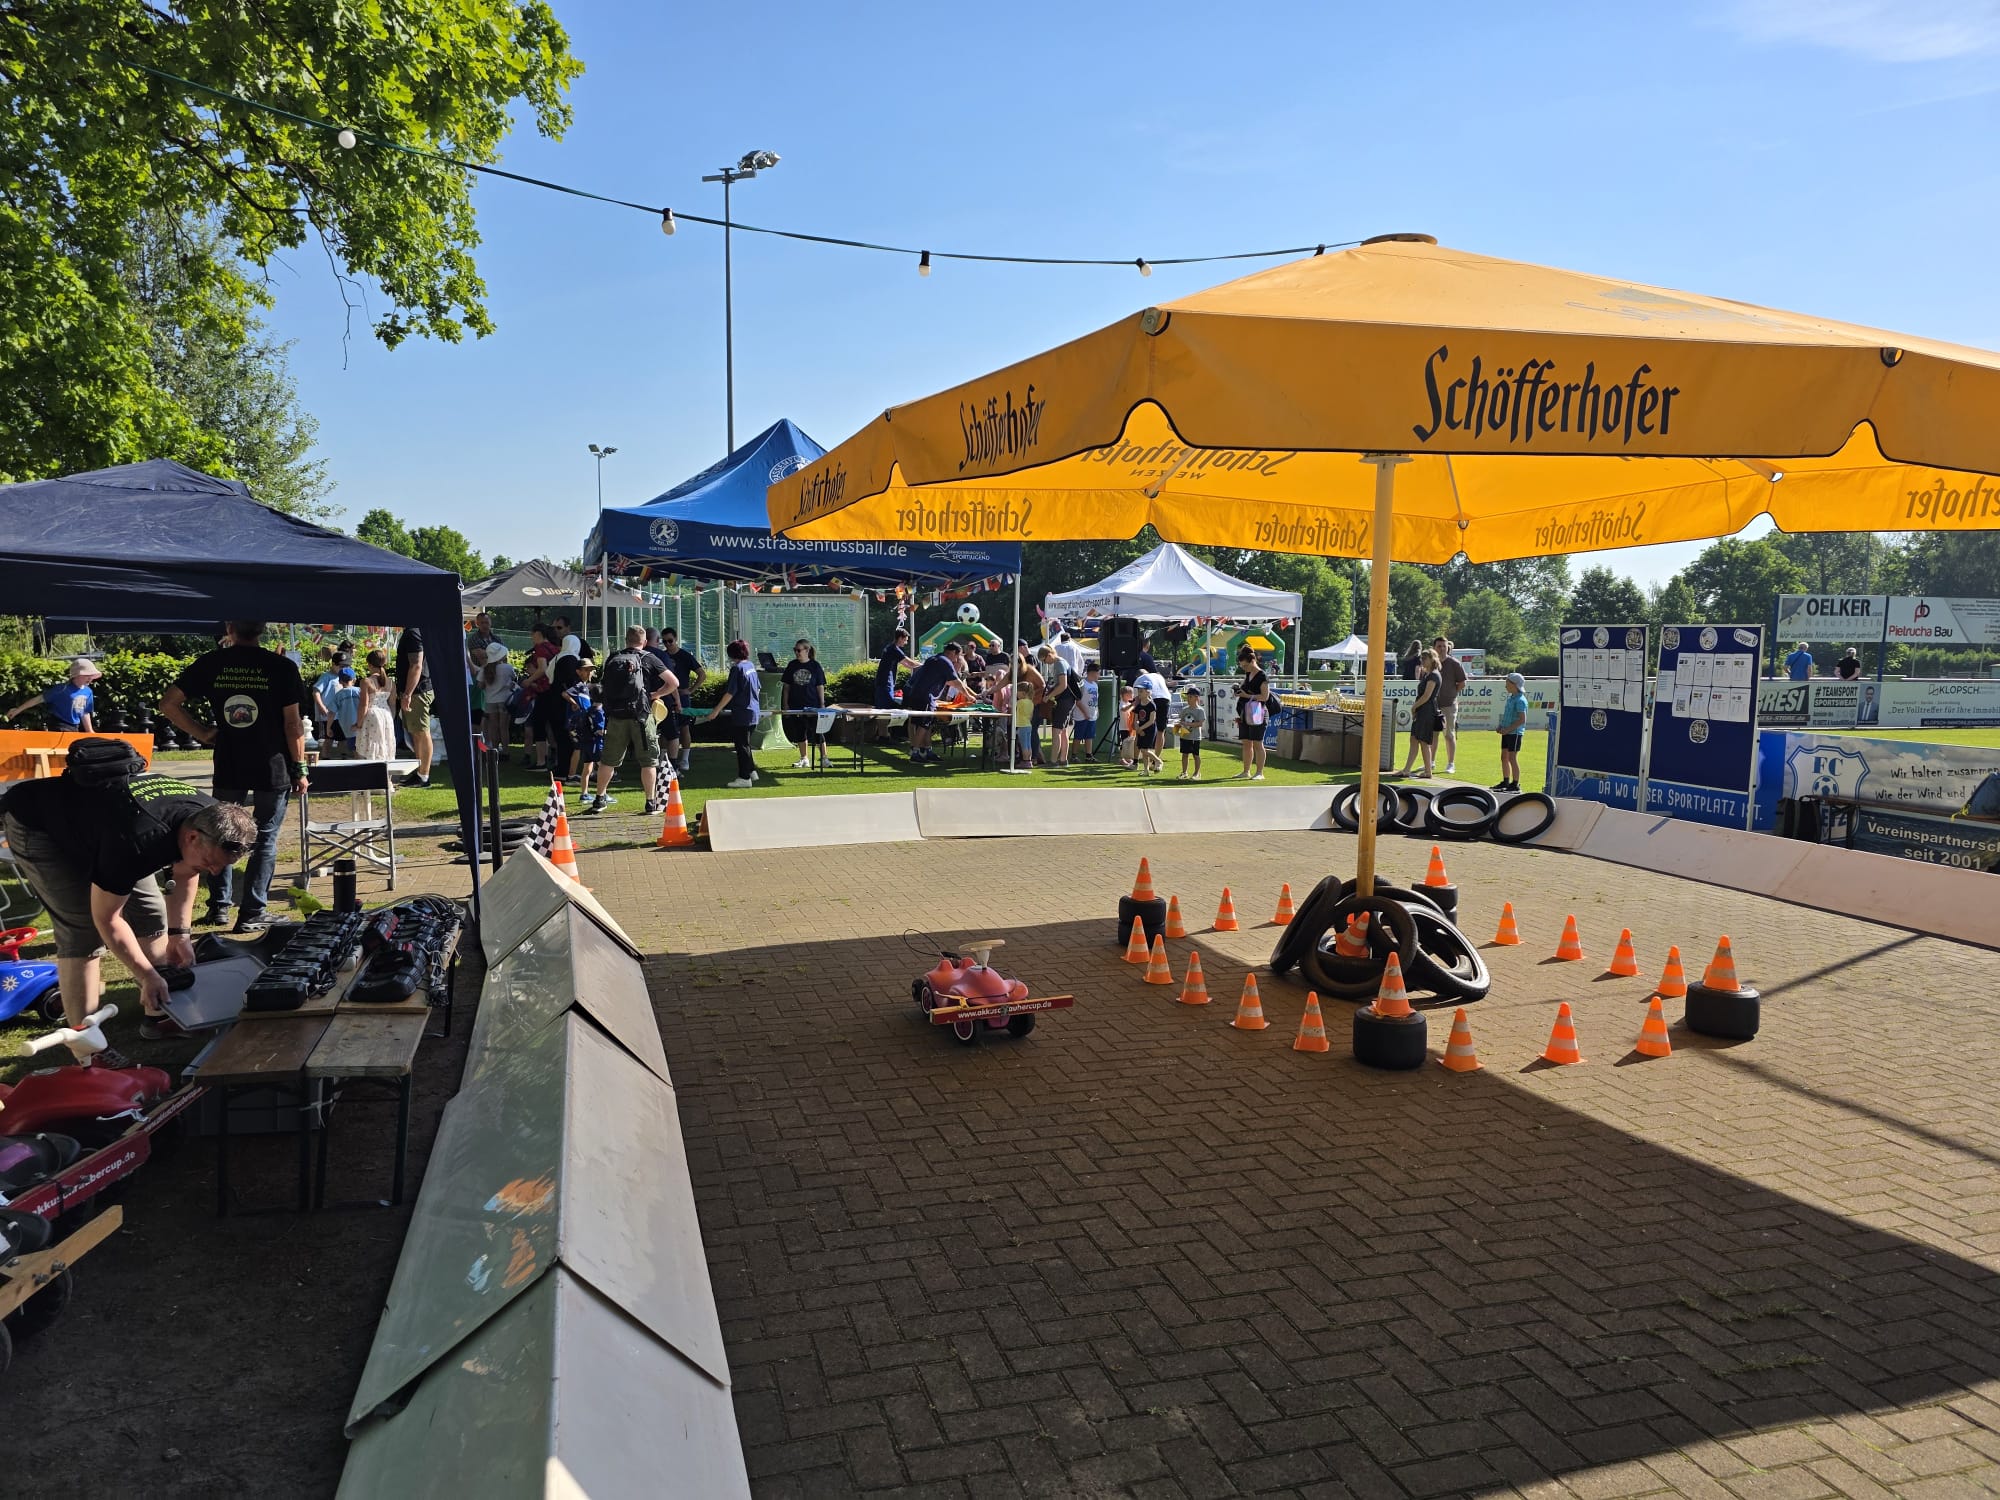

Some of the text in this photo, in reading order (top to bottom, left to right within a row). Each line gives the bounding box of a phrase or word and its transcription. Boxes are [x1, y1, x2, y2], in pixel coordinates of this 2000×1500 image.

[1413, 344, 1681, 446] Schöfferhofer
[959, 384, 1046, 472] Schöfferhofer
[710, 535, 908, 557] www.strassenfussball.de
[1888, 625, 1932, 637] Pietrucha
[1934, 626, 1953, 638] Bau
[1822, 686, 1858, 697] TEAMSPORT
[1811, 756, 1844, 777] FC
[1891, 767, 1908, 779] Wir
[1911, 765, 1944, 779] halten
[1632, 784, 1663, 804] USER
[1875, 790, 1893, 801] Wie
[1897, 788, 1913, 800] der
[1917, 787, 1943, 799] Wind
[1947, 785, 1966, 799] und
[1904, 847, 1982, 870] seit 2001
[958, 1000, 1052, 1019] www.akkuscaubercup.de
